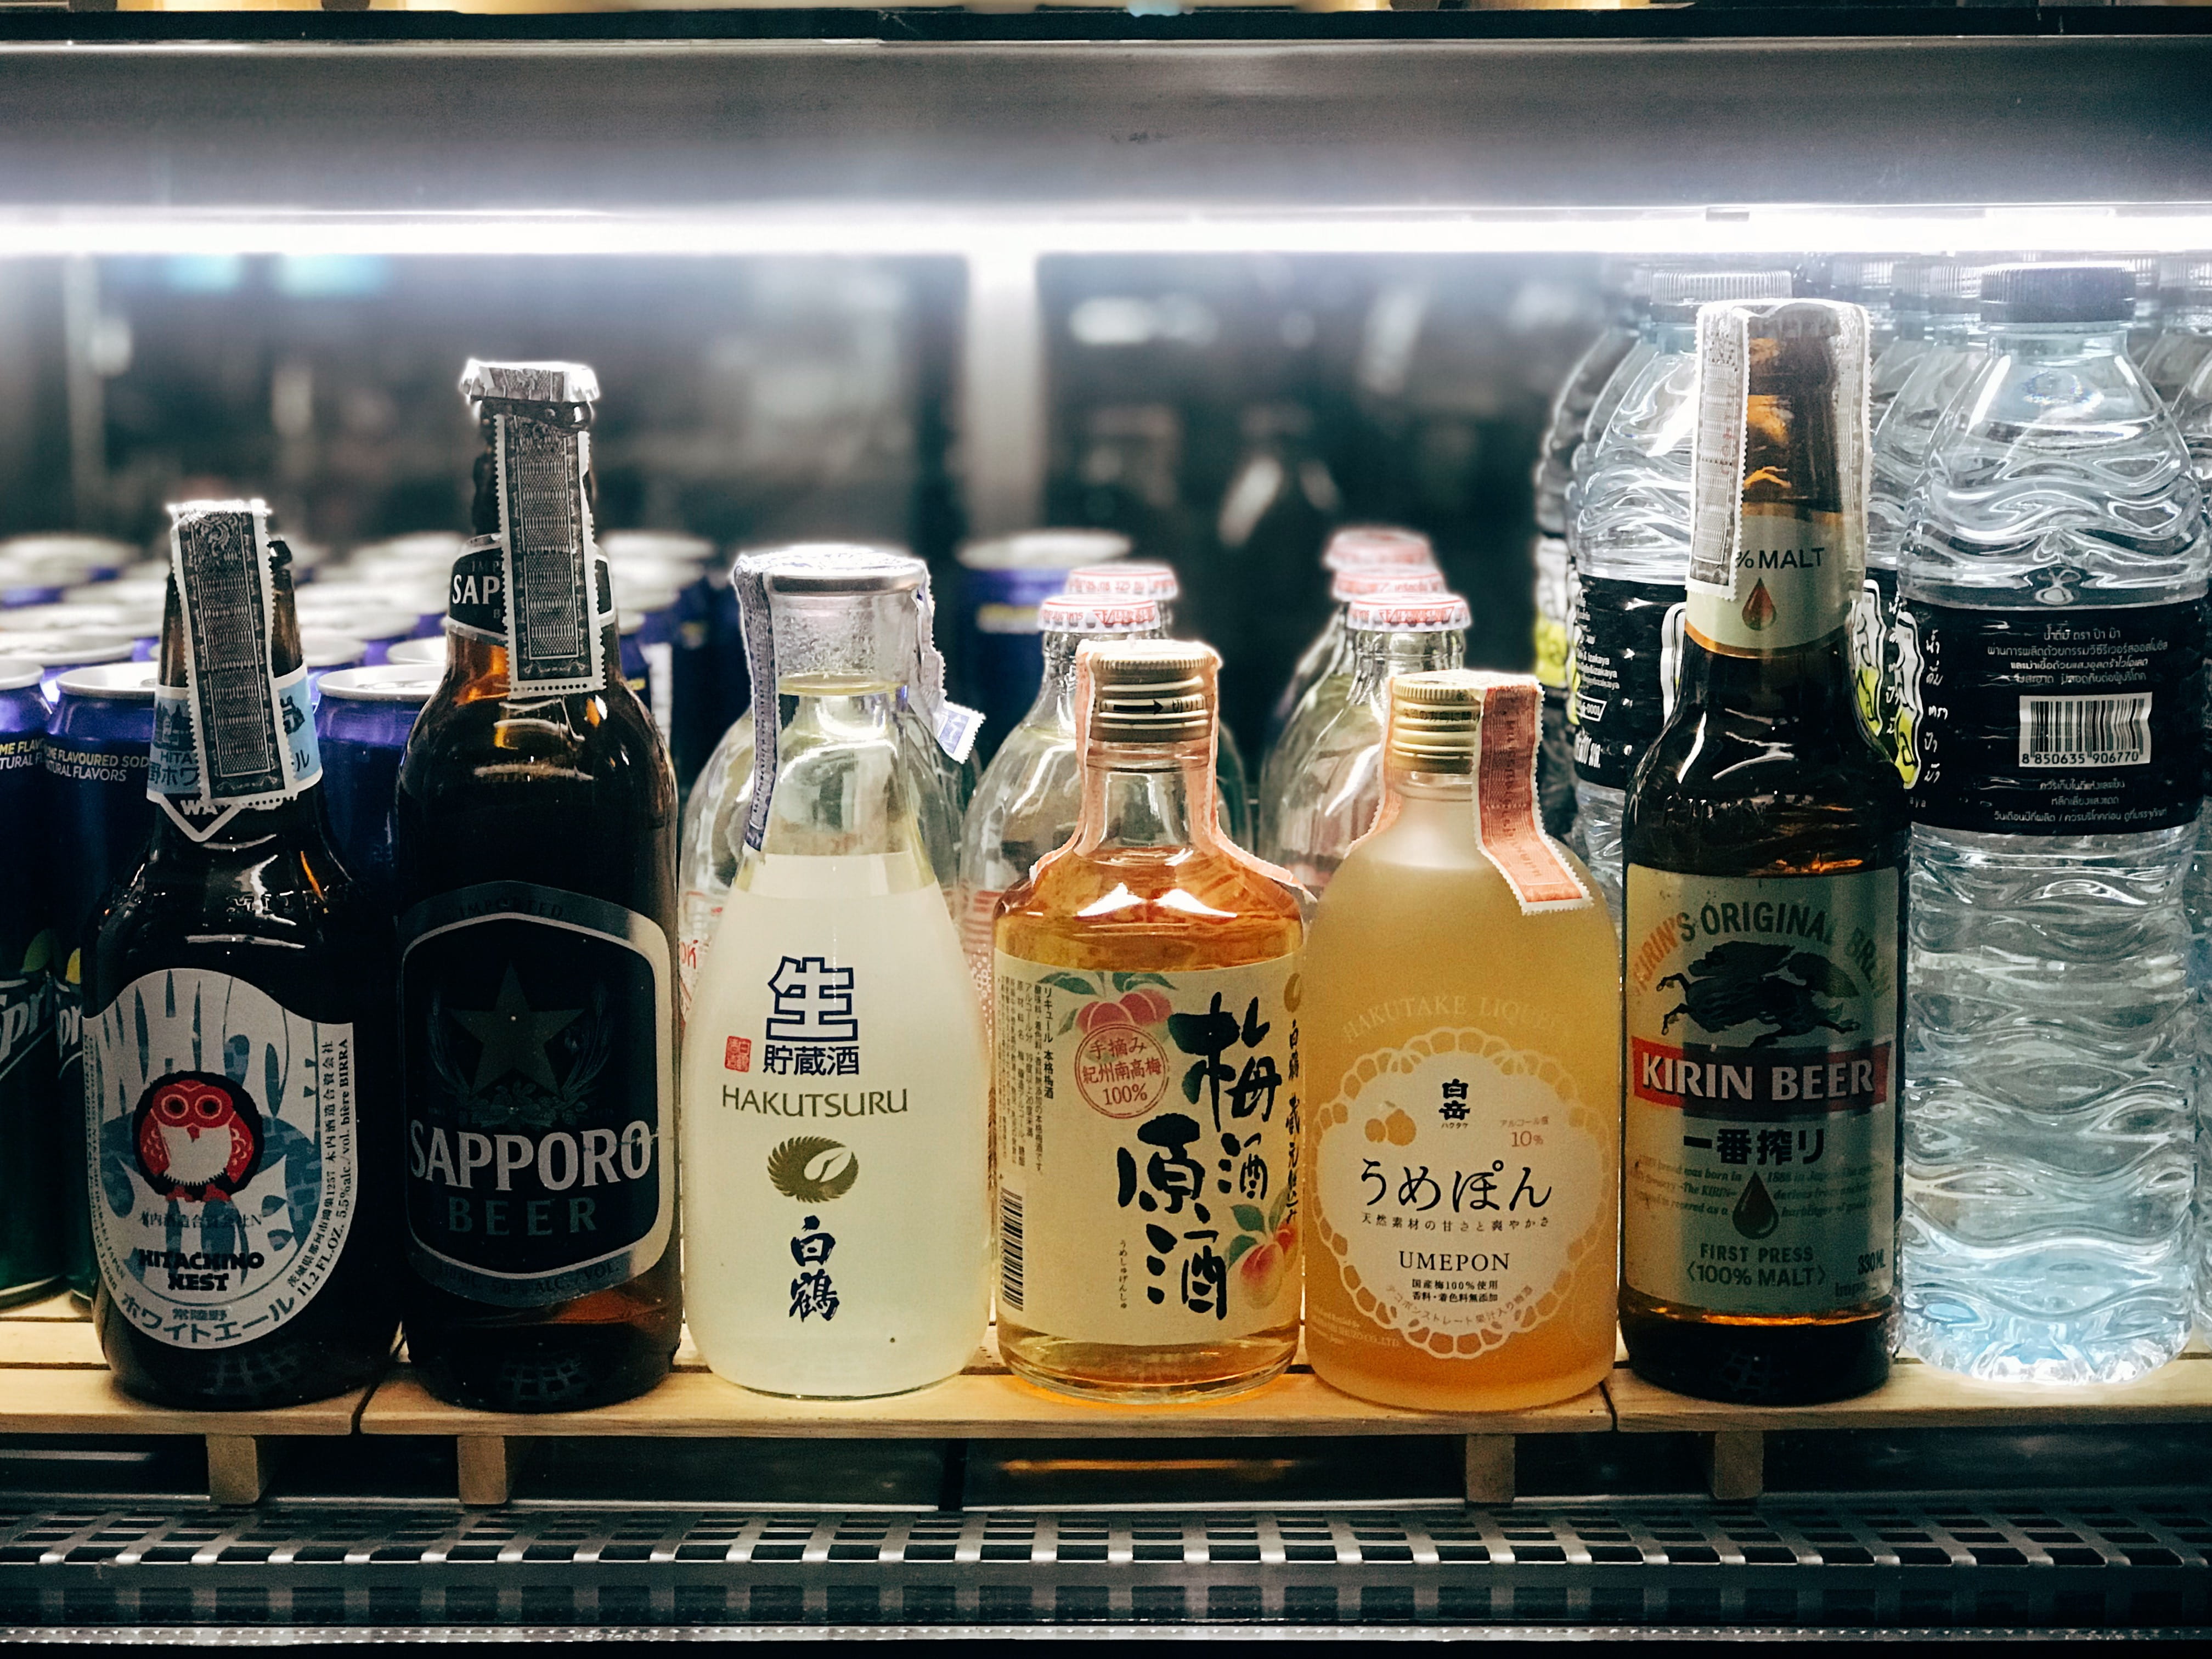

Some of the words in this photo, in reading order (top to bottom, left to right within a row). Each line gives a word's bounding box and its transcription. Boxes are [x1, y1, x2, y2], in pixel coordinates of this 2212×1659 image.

[1759, 549, 1825, 569] MALT
[58, 749, 119, 767] FLAVOURED
[121, 755, 150, 768] SOD
[2034, 752, 2085, 765] 850635
[2092, 751, 2139, 764] 906770
[73, 765, 127, 781] FLAVORS
[766, 956, 859, 1042] 生
[1343, 995, 1466, 1043] HAKUTAKE
[762, 1045, 860, 1076] 貯蔵酒
[1089, 1036, 1147, 1060] 手摘み
[1082, 1057, 1162, 1084] 紀州南高梅
[1642, 1052, 1753, 1101] KIRIN
[1771, 1059, 1875, 1101] BEER
[723, 1084, 909, 1118] HAKUTSURU
[1103, 1082, 1148, 1105] 100%
[1511, 1130, 1544, 1148] 10%
[1683, 1128, 1825, 1166] 一番搾り
[297, 1272, 331, 1297] 11.2
[338, 1039, 349, 1088] BIRRA
[410, 1119, 652, 1192] SAPPORO
[1361, 1158, 1553, 1213] うめぽん
[448, 1197, 598, 1237] BEER
[138, 1248, 265, 1270] HITACHINO
[1398, 1250, 1511, 1272] UMEPON
[1700, 1243, 1749, 1262] FIRST
[1758, 1245, 1813, 1263] PRESS
[167, 1273, 229, 1291] NEST
[789, 1215, 840, 1323] 白鶴
[121, 1293, 295, 1343] ホワイトエール
